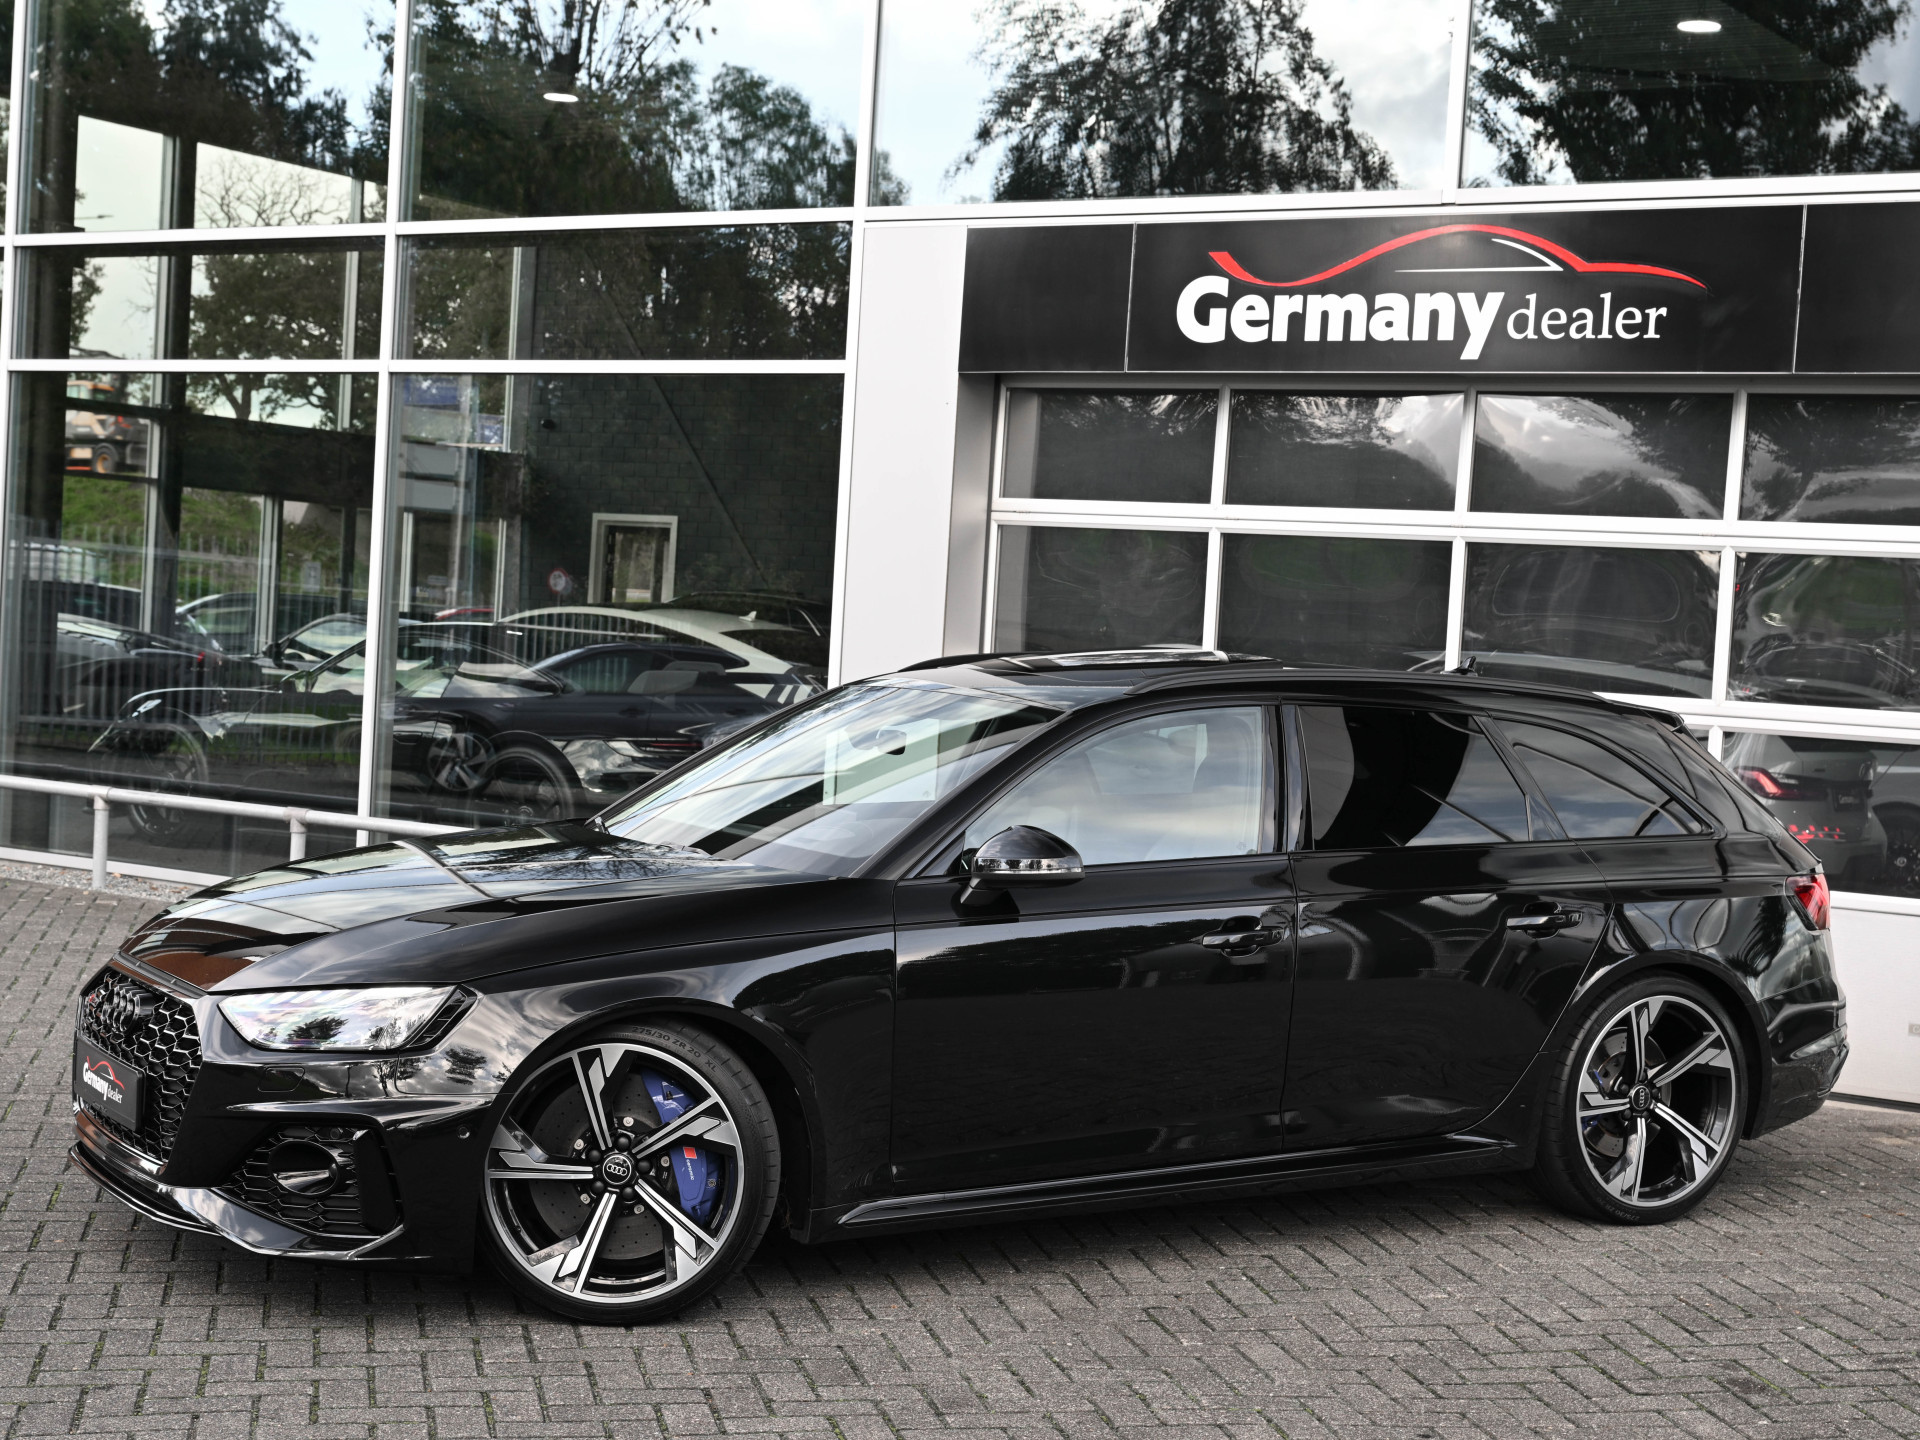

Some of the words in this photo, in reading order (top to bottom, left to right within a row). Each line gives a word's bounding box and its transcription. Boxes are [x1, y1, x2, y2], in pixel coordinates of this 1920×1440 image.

[1176, 275, 1505, 361] Germany
[1506, 293, 1668, 340] dealer
[631, 1026, 671, 1042] 275/30
[671, 1039, 687, 1050] ZR
[687, 1046, 702, 1059] 20
[704, 1060, 717, 1073] XL
[82, 1061, 109, 1101] Germany
[107, 1084, 123, 1104] dealer
